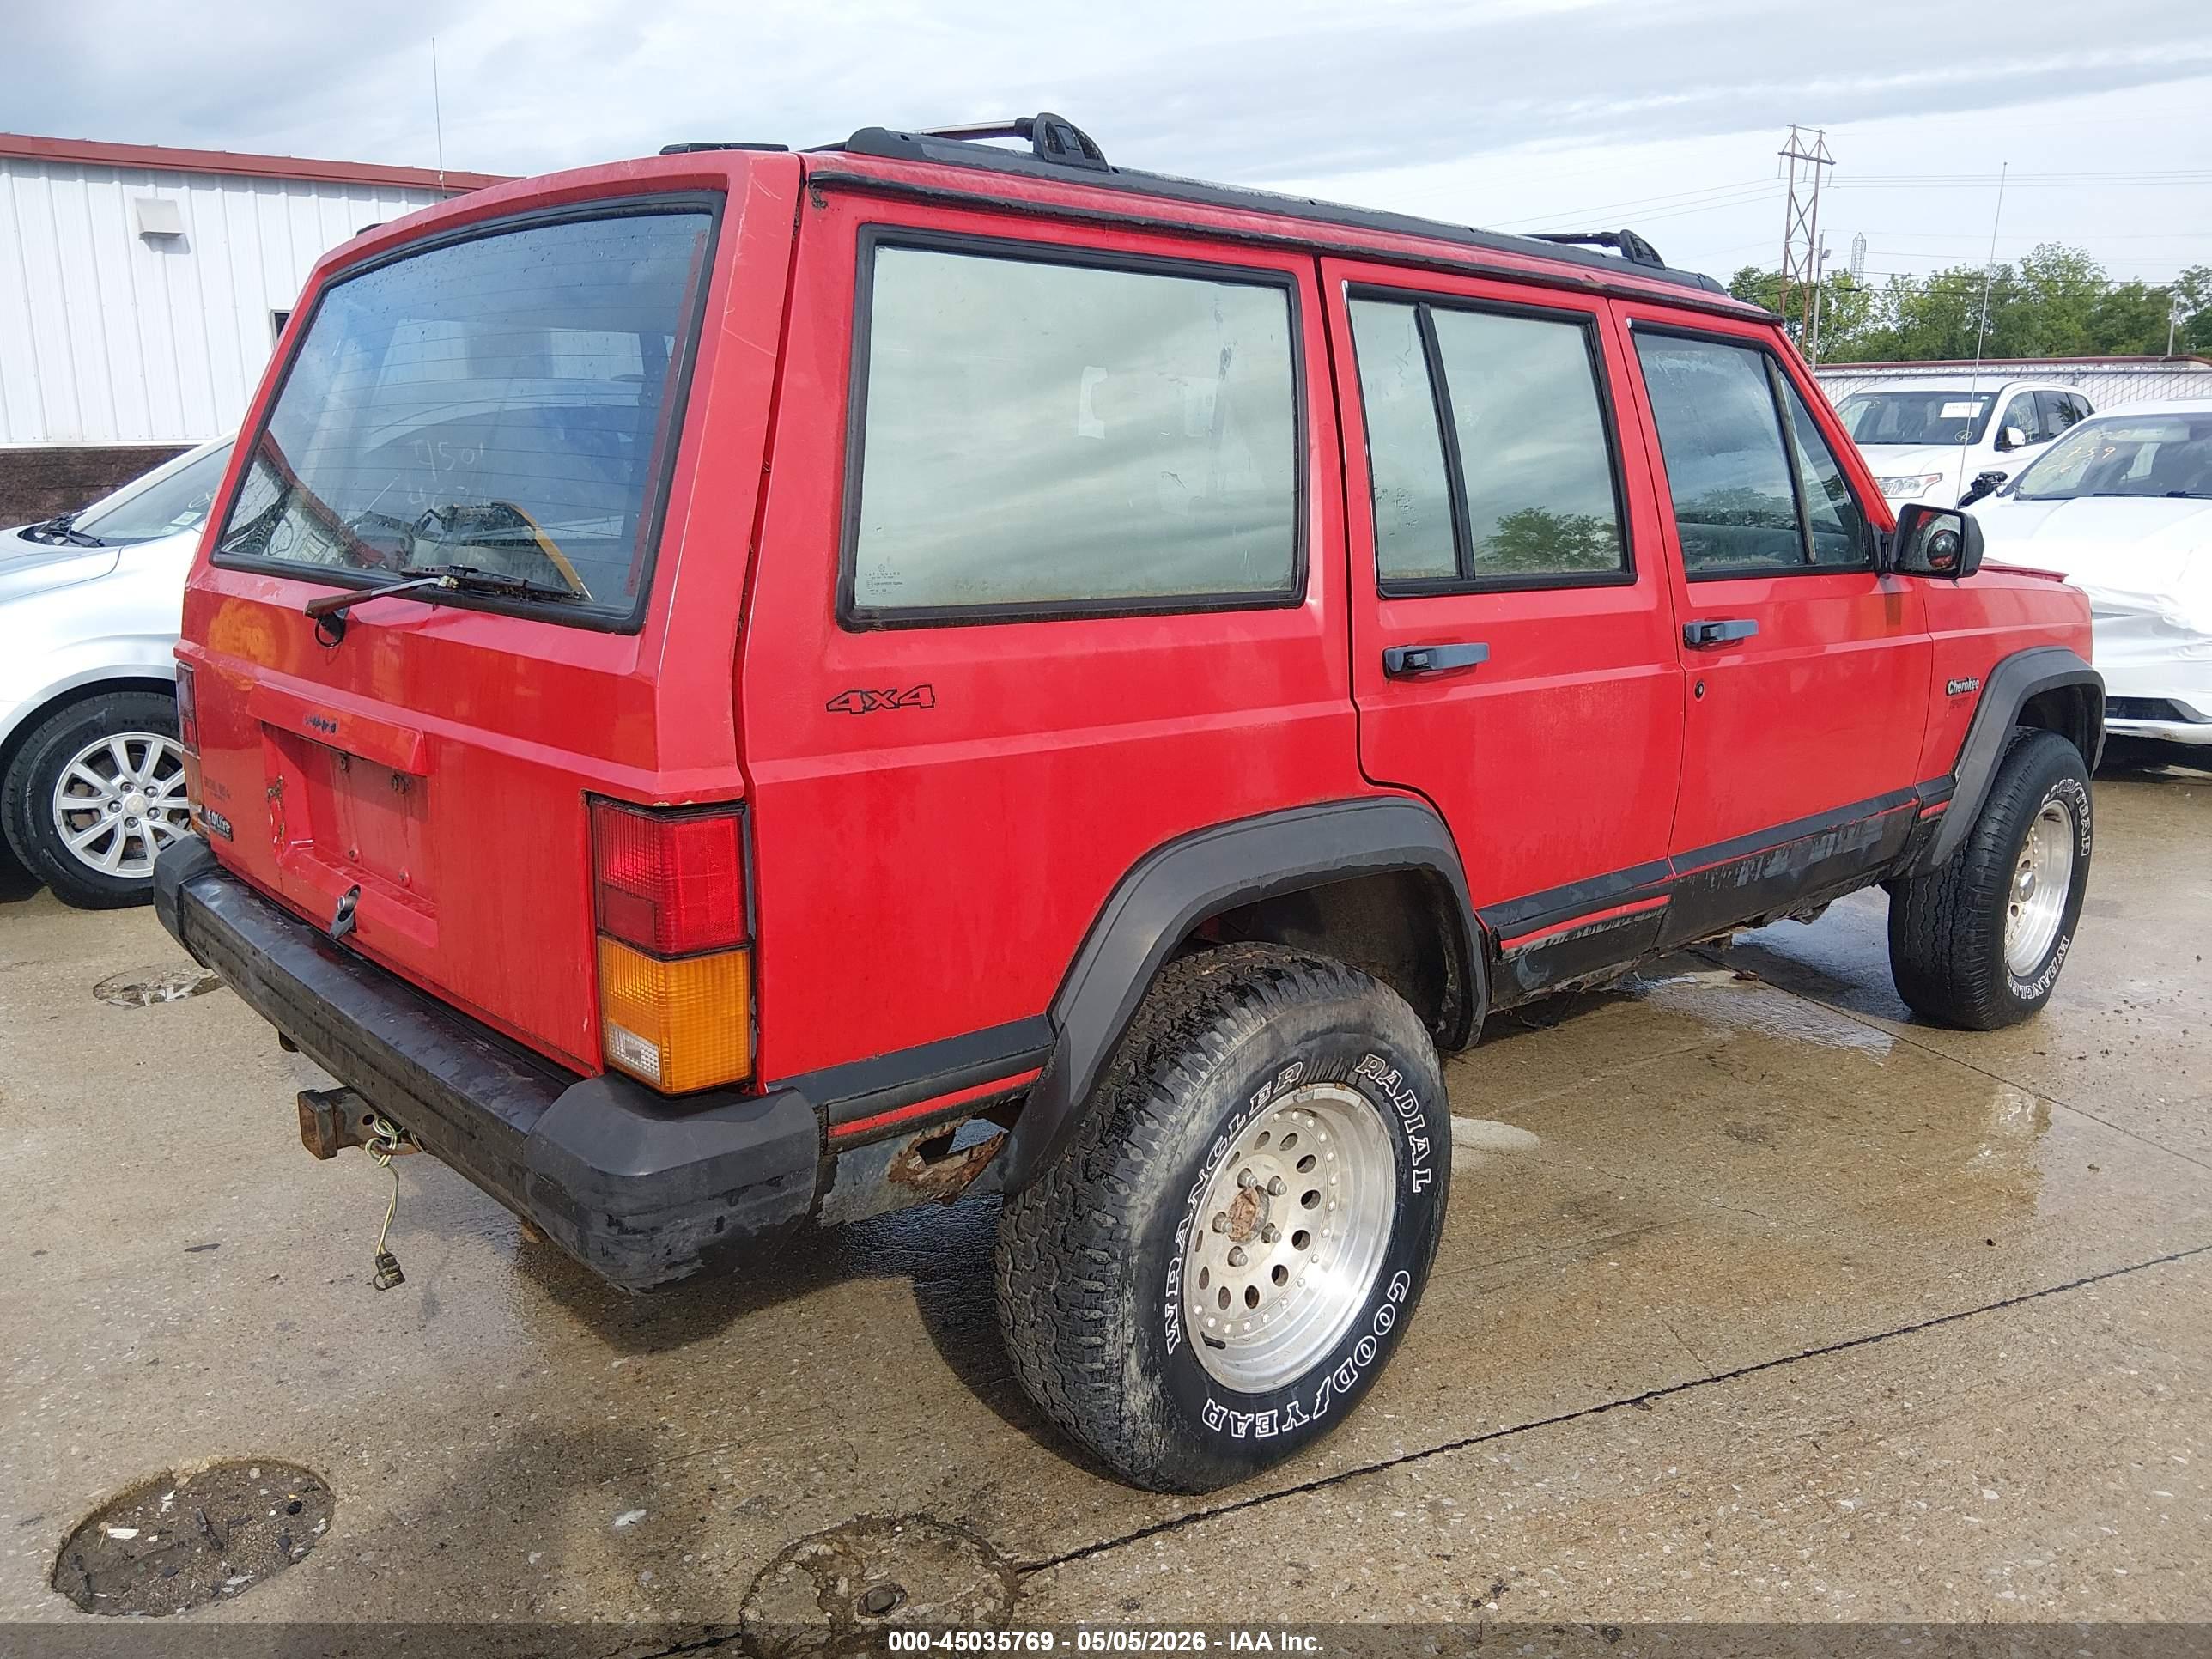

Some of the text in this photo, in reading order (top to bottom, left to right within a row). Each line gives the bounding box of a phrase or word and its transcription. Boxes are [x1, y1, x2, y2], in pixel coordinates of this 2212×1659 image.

[1948, 678, 1979, 695] Cherokee
[2006, 935, 2070, 1000] WRANGLER
[1164, 1054, 1432, 1354] WRANGLER RADIAL
